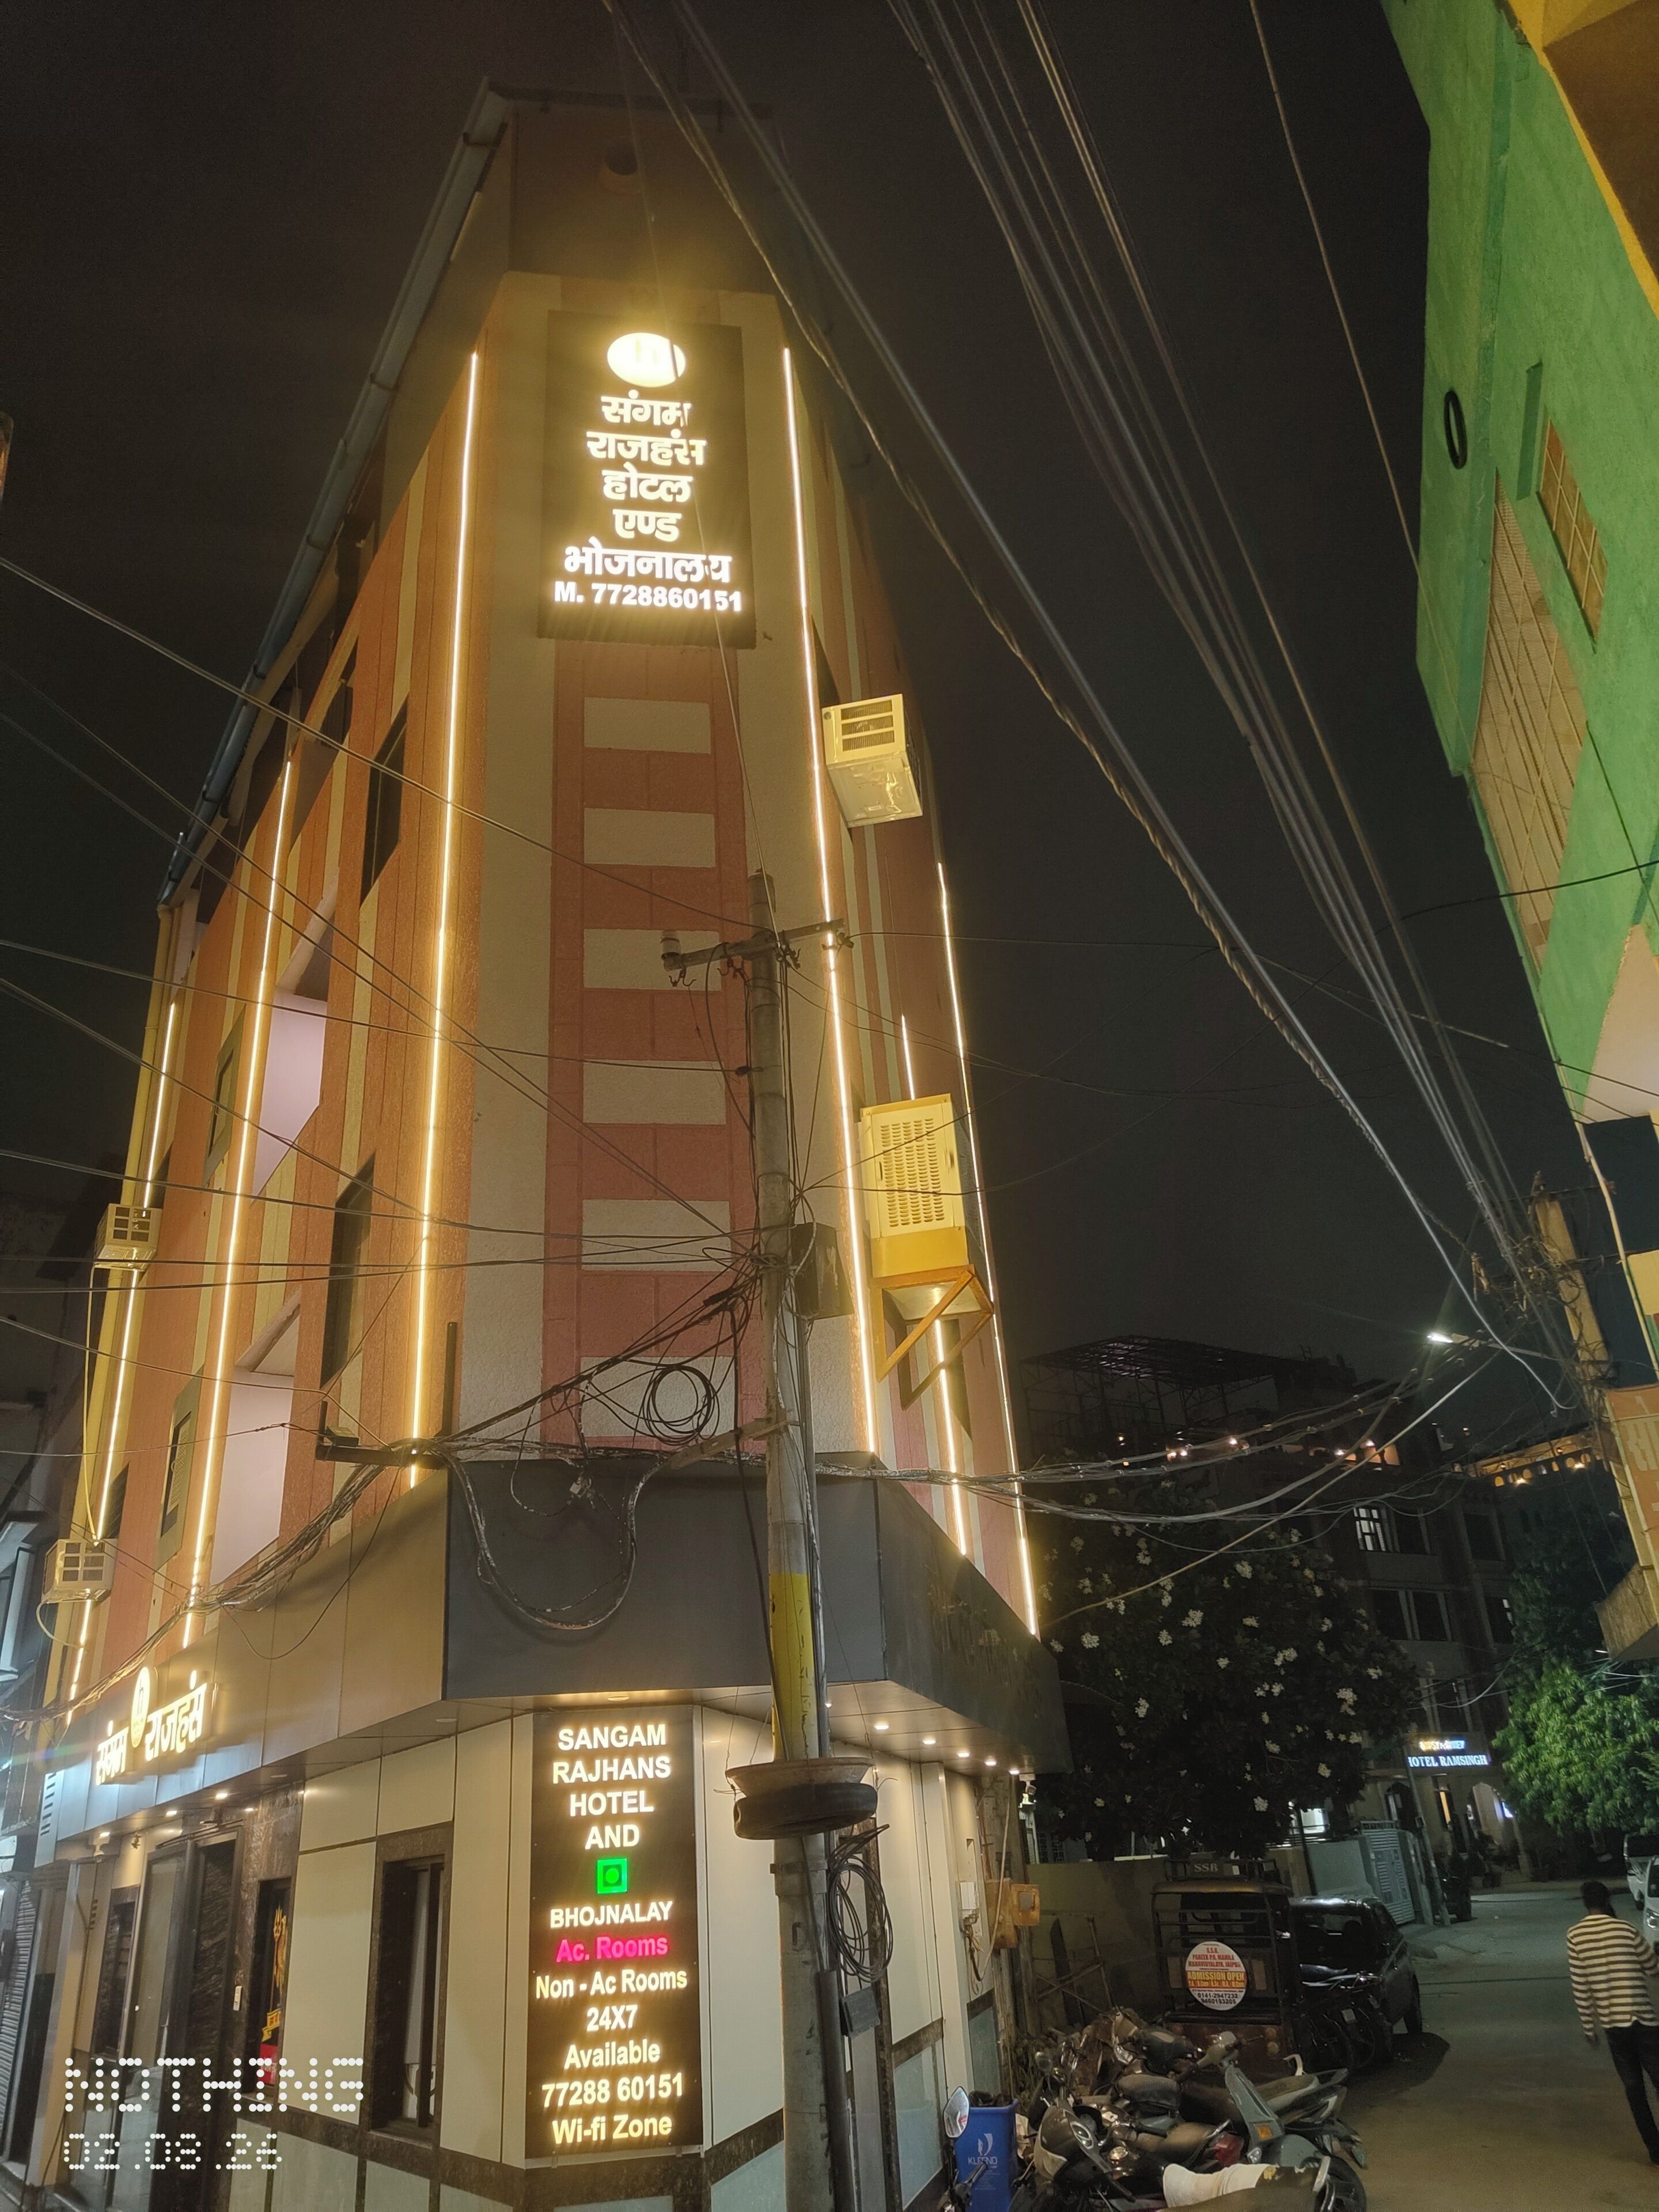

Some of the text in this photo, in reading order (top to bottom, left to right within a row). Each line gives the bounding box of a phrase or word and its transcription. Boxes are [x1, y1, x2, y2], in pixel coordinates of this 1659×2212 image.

[601, 389, 692, 427] संगम
[586, 429, 707, 466] राजहंस
[601, 462, 694, 503] होटल
[612, 508, 682, 541] एण्ड
[564, 536, 732, 583] भोजनालय
[554, 581, 743, 612] M. 7728860151
[144, 1670, 207, 1762] राजहंस
[558, 1724, 666, 1751] SANGAM
[552, 1756, 671, 1784] RAJHANS
[1438, 1755, 1488, 1767] RAMSINGH
[569, 1790, 655, 1817] HOTEL
[585, 1824, 640, 1850] AND
[550, 1900, 673, 1929] BHOJNALAY
[556, 1936, 669, 1963] Ac. Rooms
[536, 1975, 574, 1999] Non
[590, 1971, 617, 1995] Ac
[622, 1969, 688, 1993] Rooms
[1188, 1971, 1244, 1981] ADMISSION OPEN
[586, 2004, 638, 2032] 24X7
[564, 2038, 661, 2070] Available
[541, 2072, 683, 2108] 77288 60151
[552, 2114, 673, 2145] Wi-fi Zone
